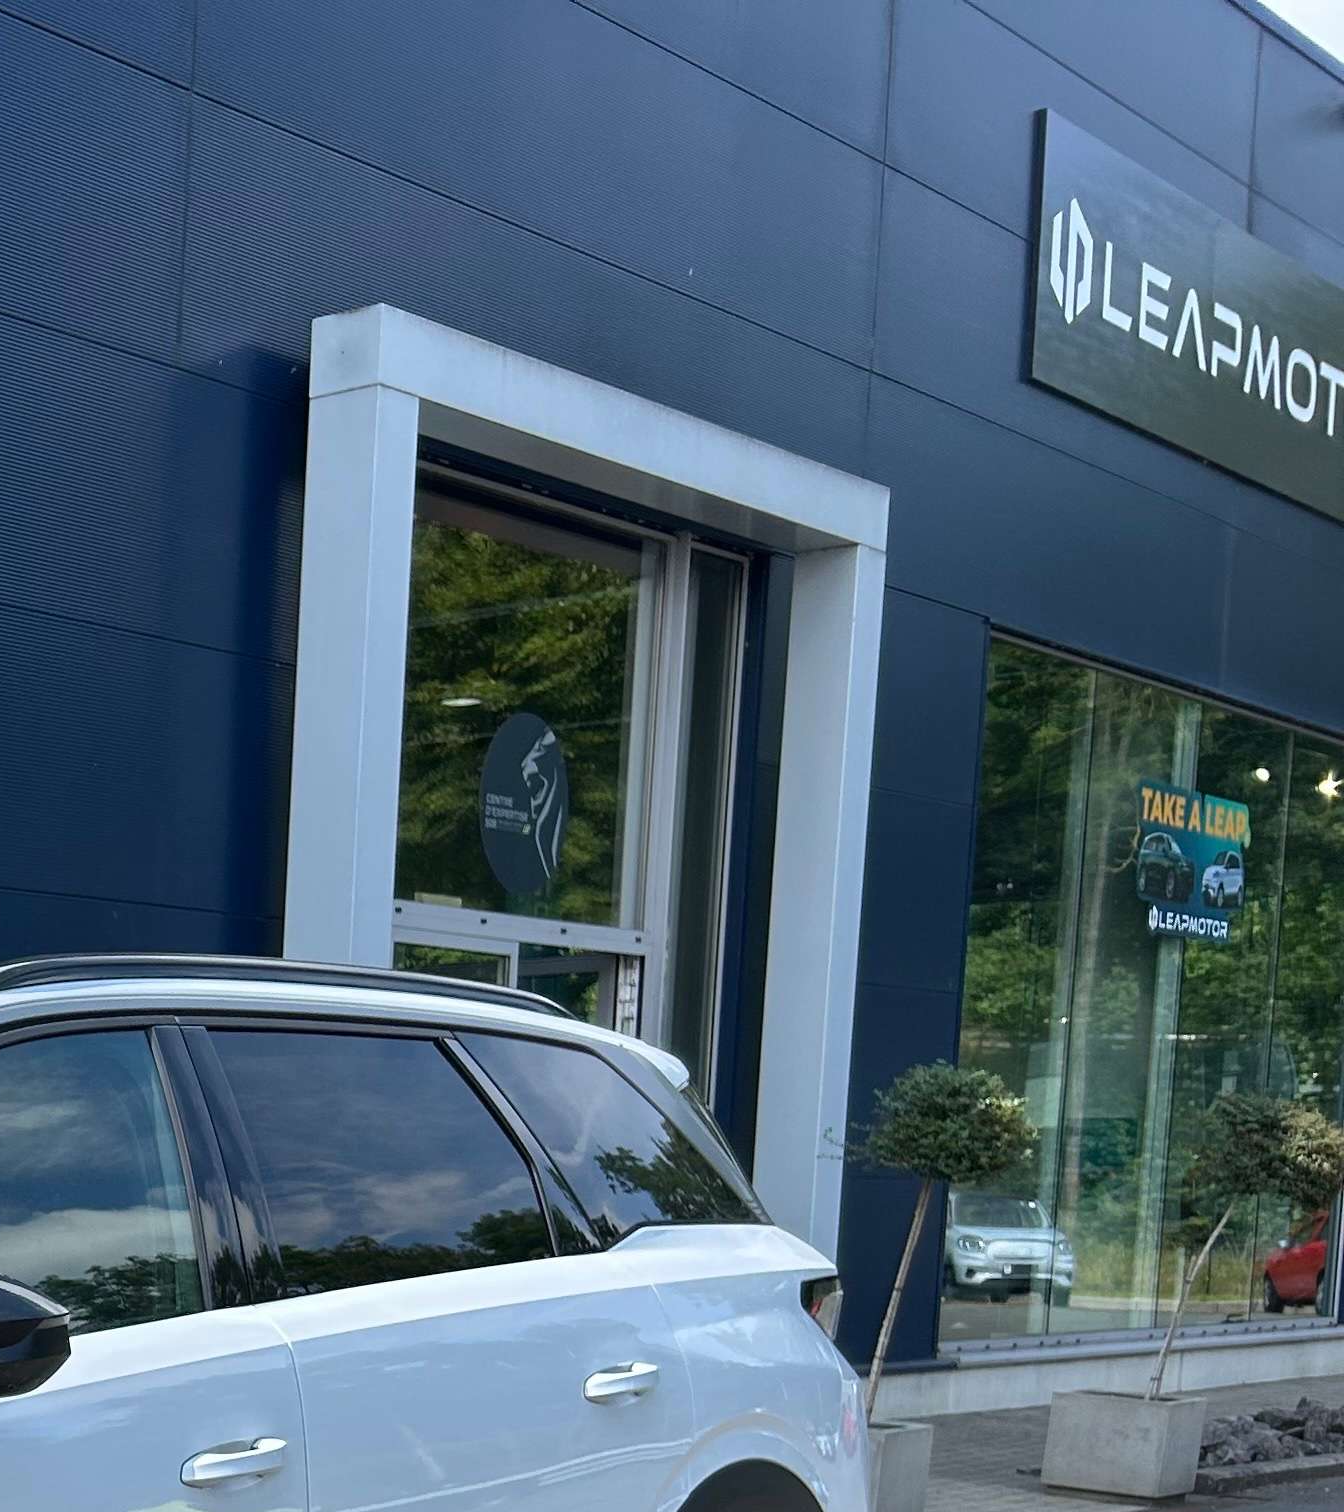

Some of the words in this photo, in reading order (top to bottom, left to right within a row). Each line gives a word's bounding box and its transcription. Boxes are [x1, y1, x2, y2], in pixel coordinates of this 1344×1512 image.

[1102, 241, 1344, 436] LEAPMOT
[1142, 787, 1186, 829] TAKE
[1188, 797, 1201, 833] A
[1205, 804, 1247, 841] LEAP
[1158, 911, 1228, 939] LEAPMOTOR
